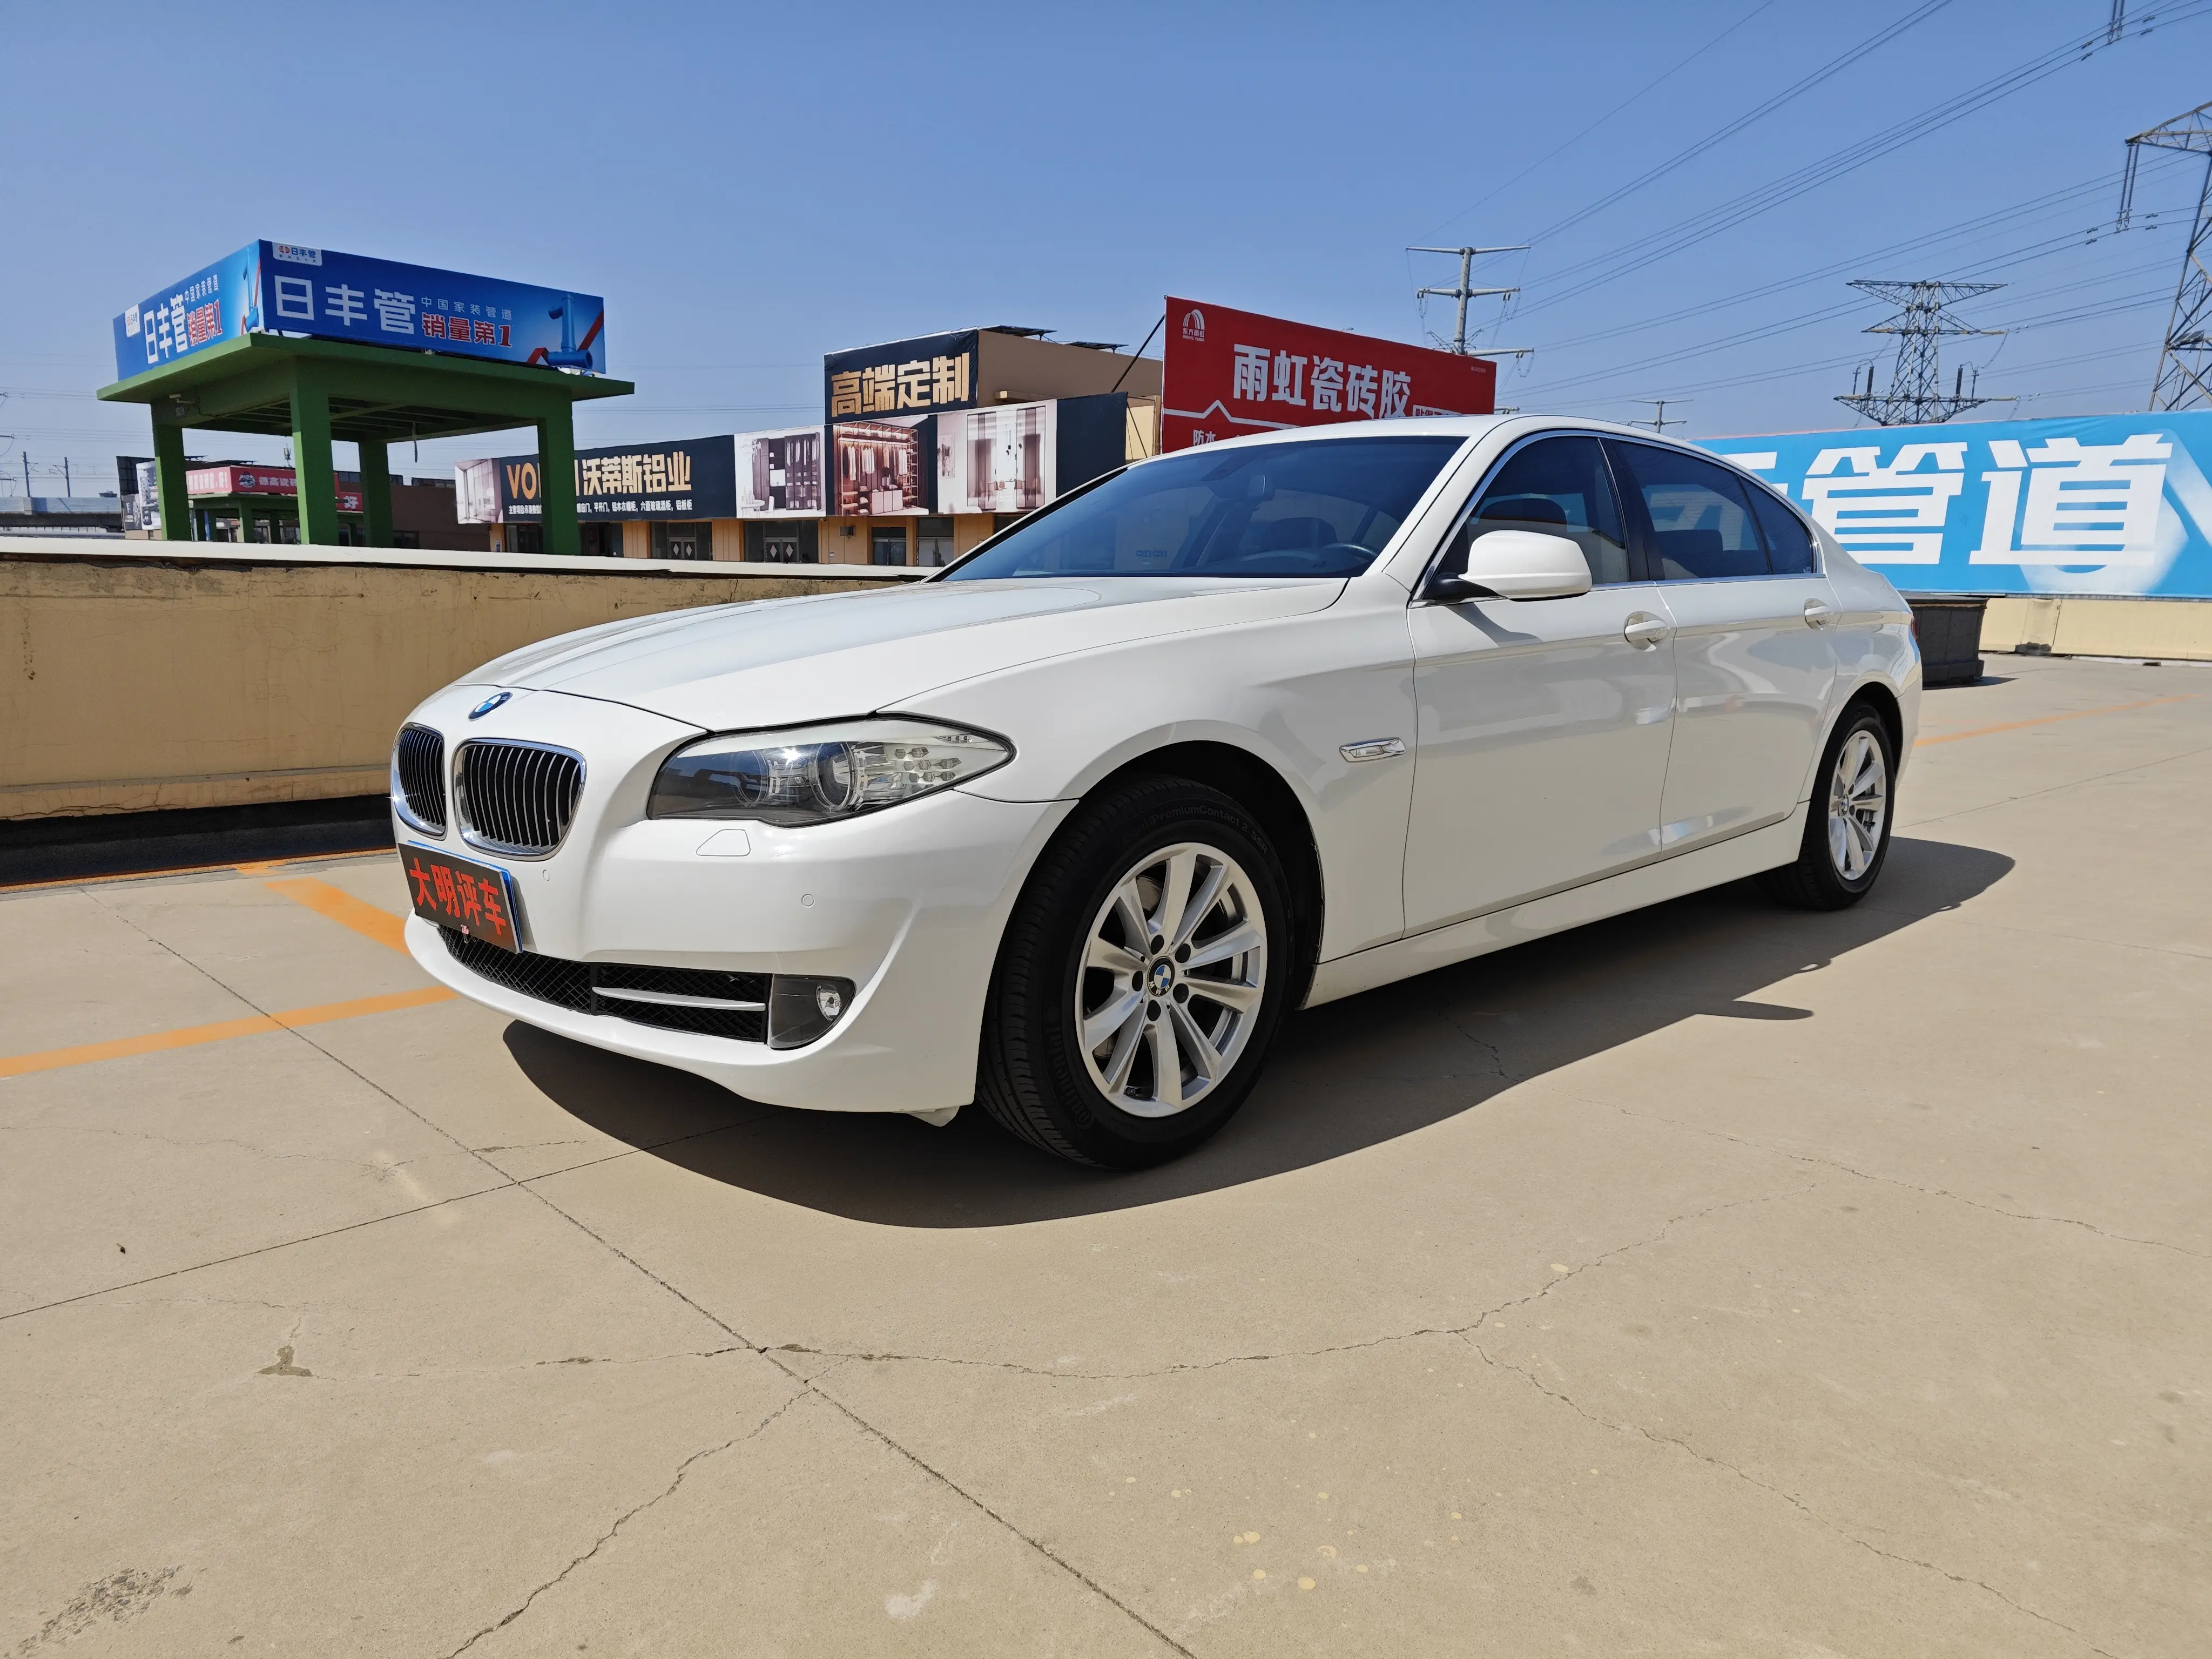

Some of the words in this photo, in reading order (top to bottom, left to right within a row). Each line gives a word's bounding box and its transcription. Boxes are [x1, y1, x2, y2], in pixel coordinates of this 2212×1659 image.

[292, 247, 316, 258] 日丰管
[187, 298, 222, 347] 销量第1
[274, 275, 416, 335] 日丰管
[421, 296, 512, 320] 中国家装管道
[144, 294, 188, 364] 日丰管
[421, 312, 512, 348] 销量第1
[831, 352, 970, 417] 高端定制
[1233, 343, 1411, 419] 雨虹瓷砖胶
[506, 462, 541, 500] VO
[582, 451, 692, 496] 沃蒂斯铝业
[343, 496, 359, 509] 好
[1723, 434, 2173, 565] 管道
[409, 858, 507, 935] 大明评车
[1149, 981, 1170, 995] BMW
